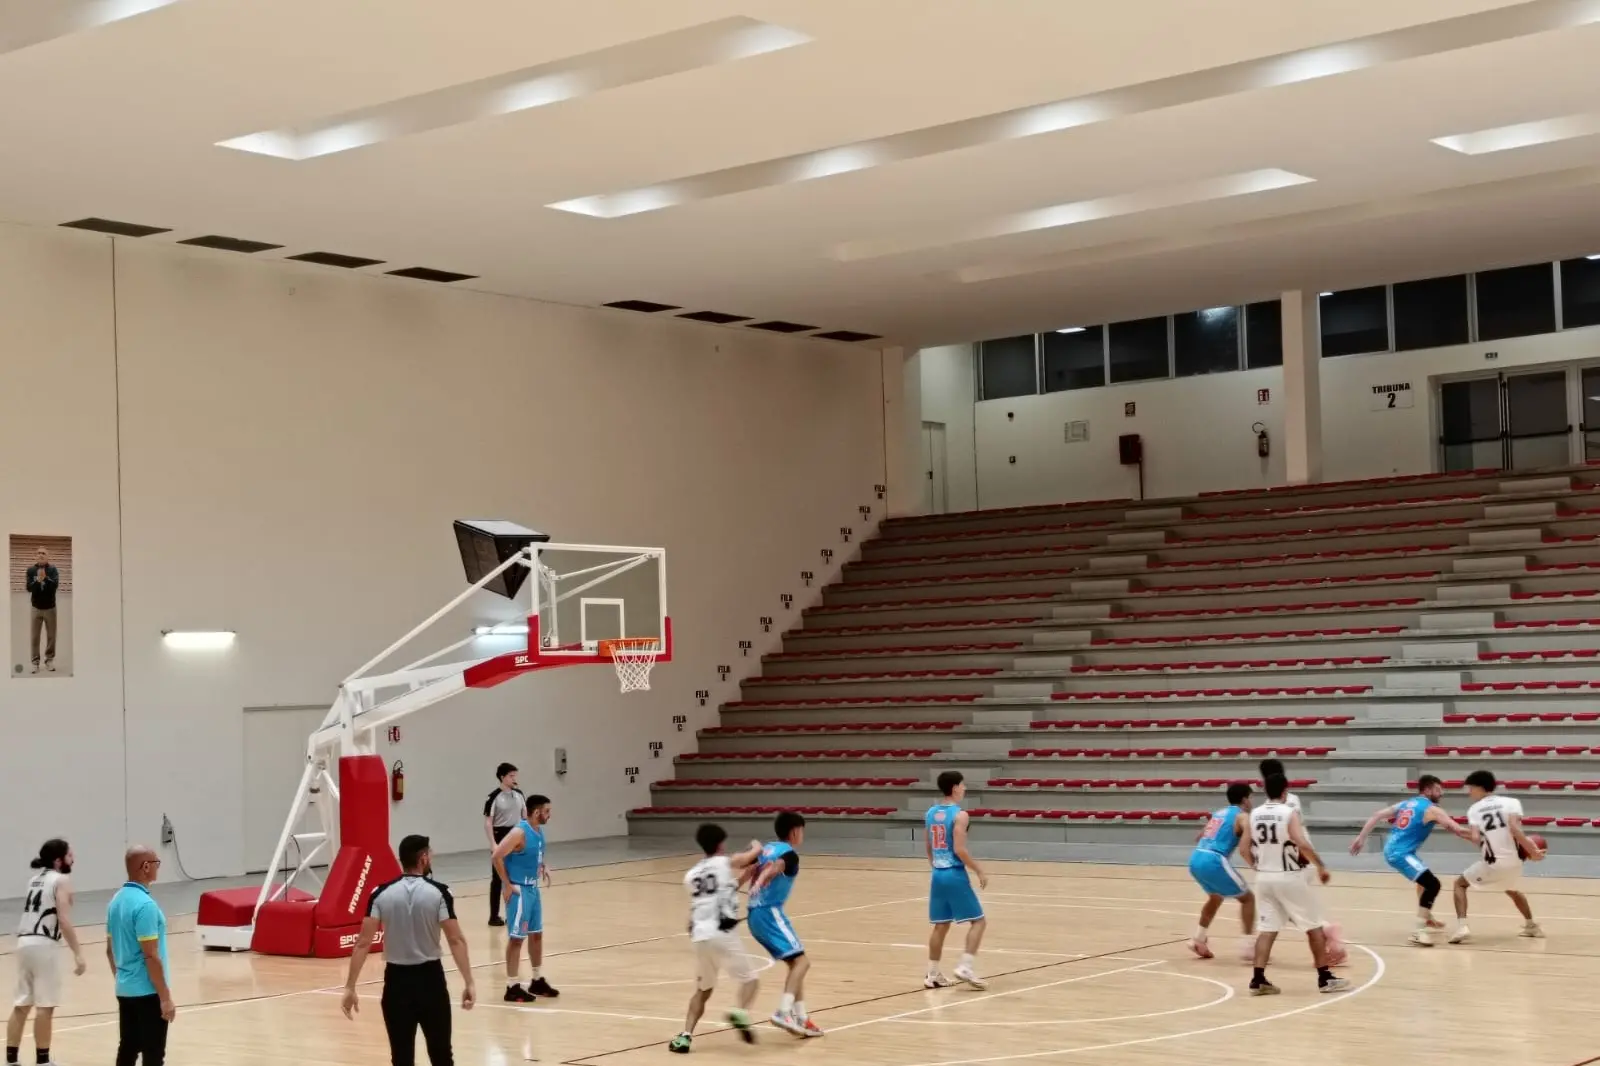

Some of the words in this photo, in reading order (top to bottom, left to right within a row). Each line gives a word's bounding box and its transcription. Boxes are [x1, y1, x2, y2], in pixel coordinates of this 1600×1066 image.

[1372, 382, 1411, 394] TRIBUNA
[1387, 393, 1396, 408] 2
[696, 690, 709, 698] FILA
[649, 742, 663, 750] FILA
[625, 767, 639, 775] FILA
[1482, 811, 1506, 831] 21
[1255, 823, 1279, 844] 31
[348, 854, 372, 914] HYDROPLAY
[24, 889, 43, 912] 14
